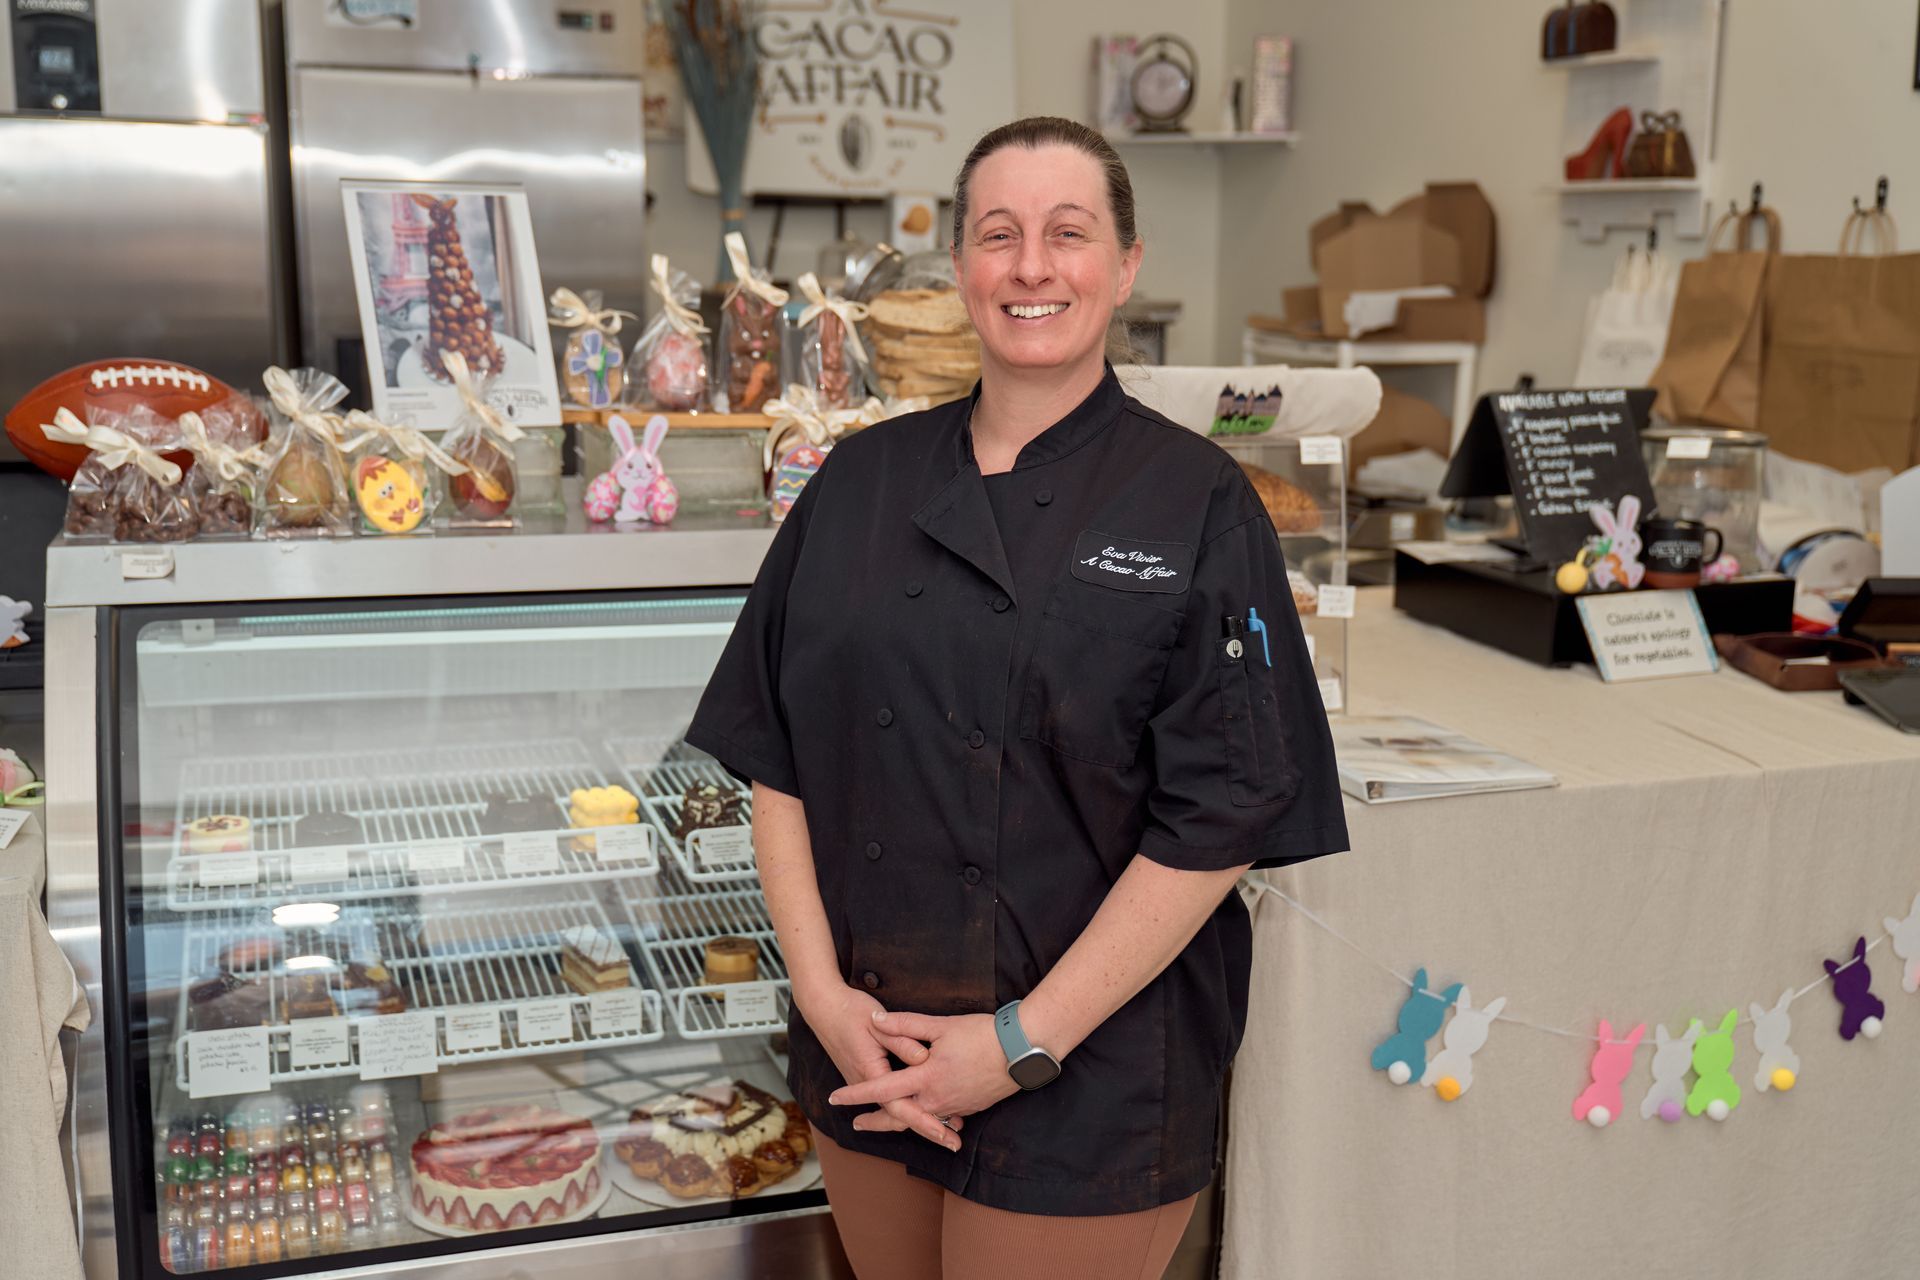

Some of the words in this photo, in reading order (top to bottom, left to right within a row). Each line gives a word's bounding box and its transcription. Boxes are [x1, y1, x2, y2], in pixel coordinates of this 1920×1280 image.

[755, 16, 954, 70] CACAO
[766, 65, 945, 114] AFFAIR
[1080, 556, 1099, 566] A
[1098, 559, 1136, 575] Cacao
[1135, 565, 1178, 580] Affair
[1101, 546, 1127, 560] Eva
[1128, 551, 1163, 563] Vivier
